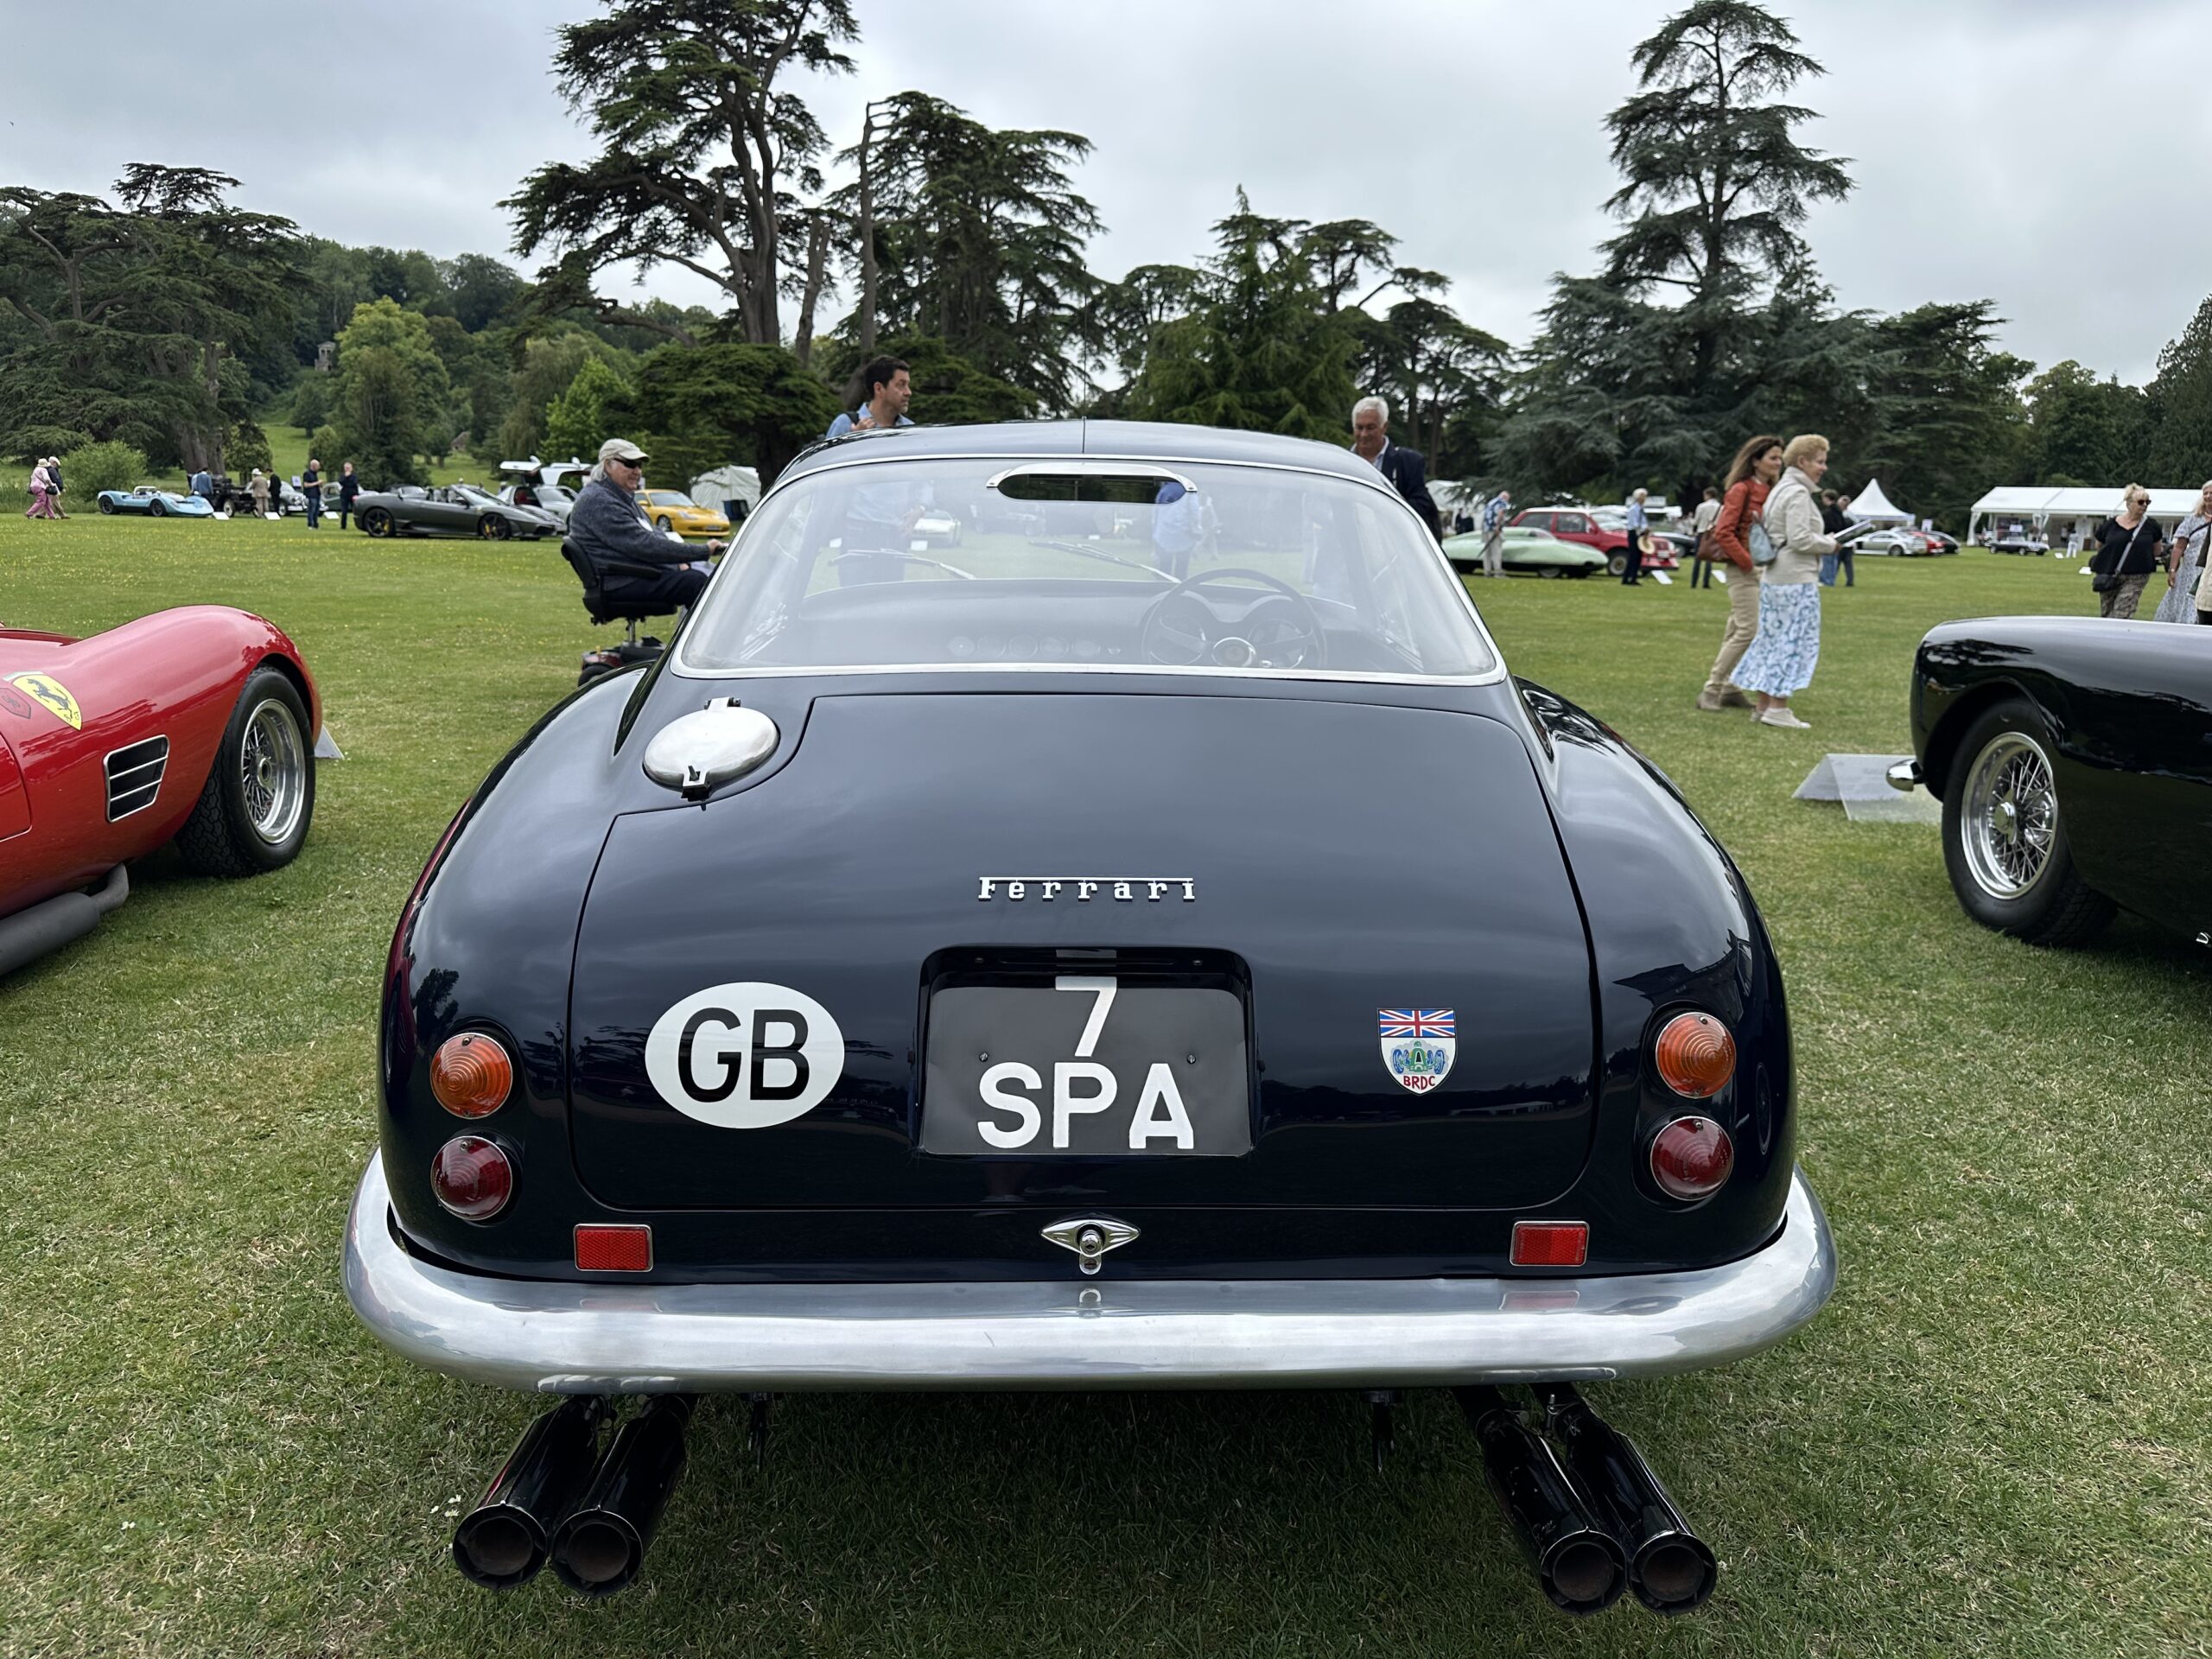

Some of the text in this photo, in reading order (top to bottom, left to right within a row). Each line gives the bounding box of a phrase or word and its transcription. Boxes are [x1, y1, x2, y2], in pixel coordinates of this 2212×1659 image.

[977, 877, 1196, 900] Ferrari
[678, 1007, 810, 1103] GB
[1055, 976, 1117, 1058] 7
[977, 1062, 1194, 1149] SPA
[1402, 1075, 1436, 1090] BRDC
